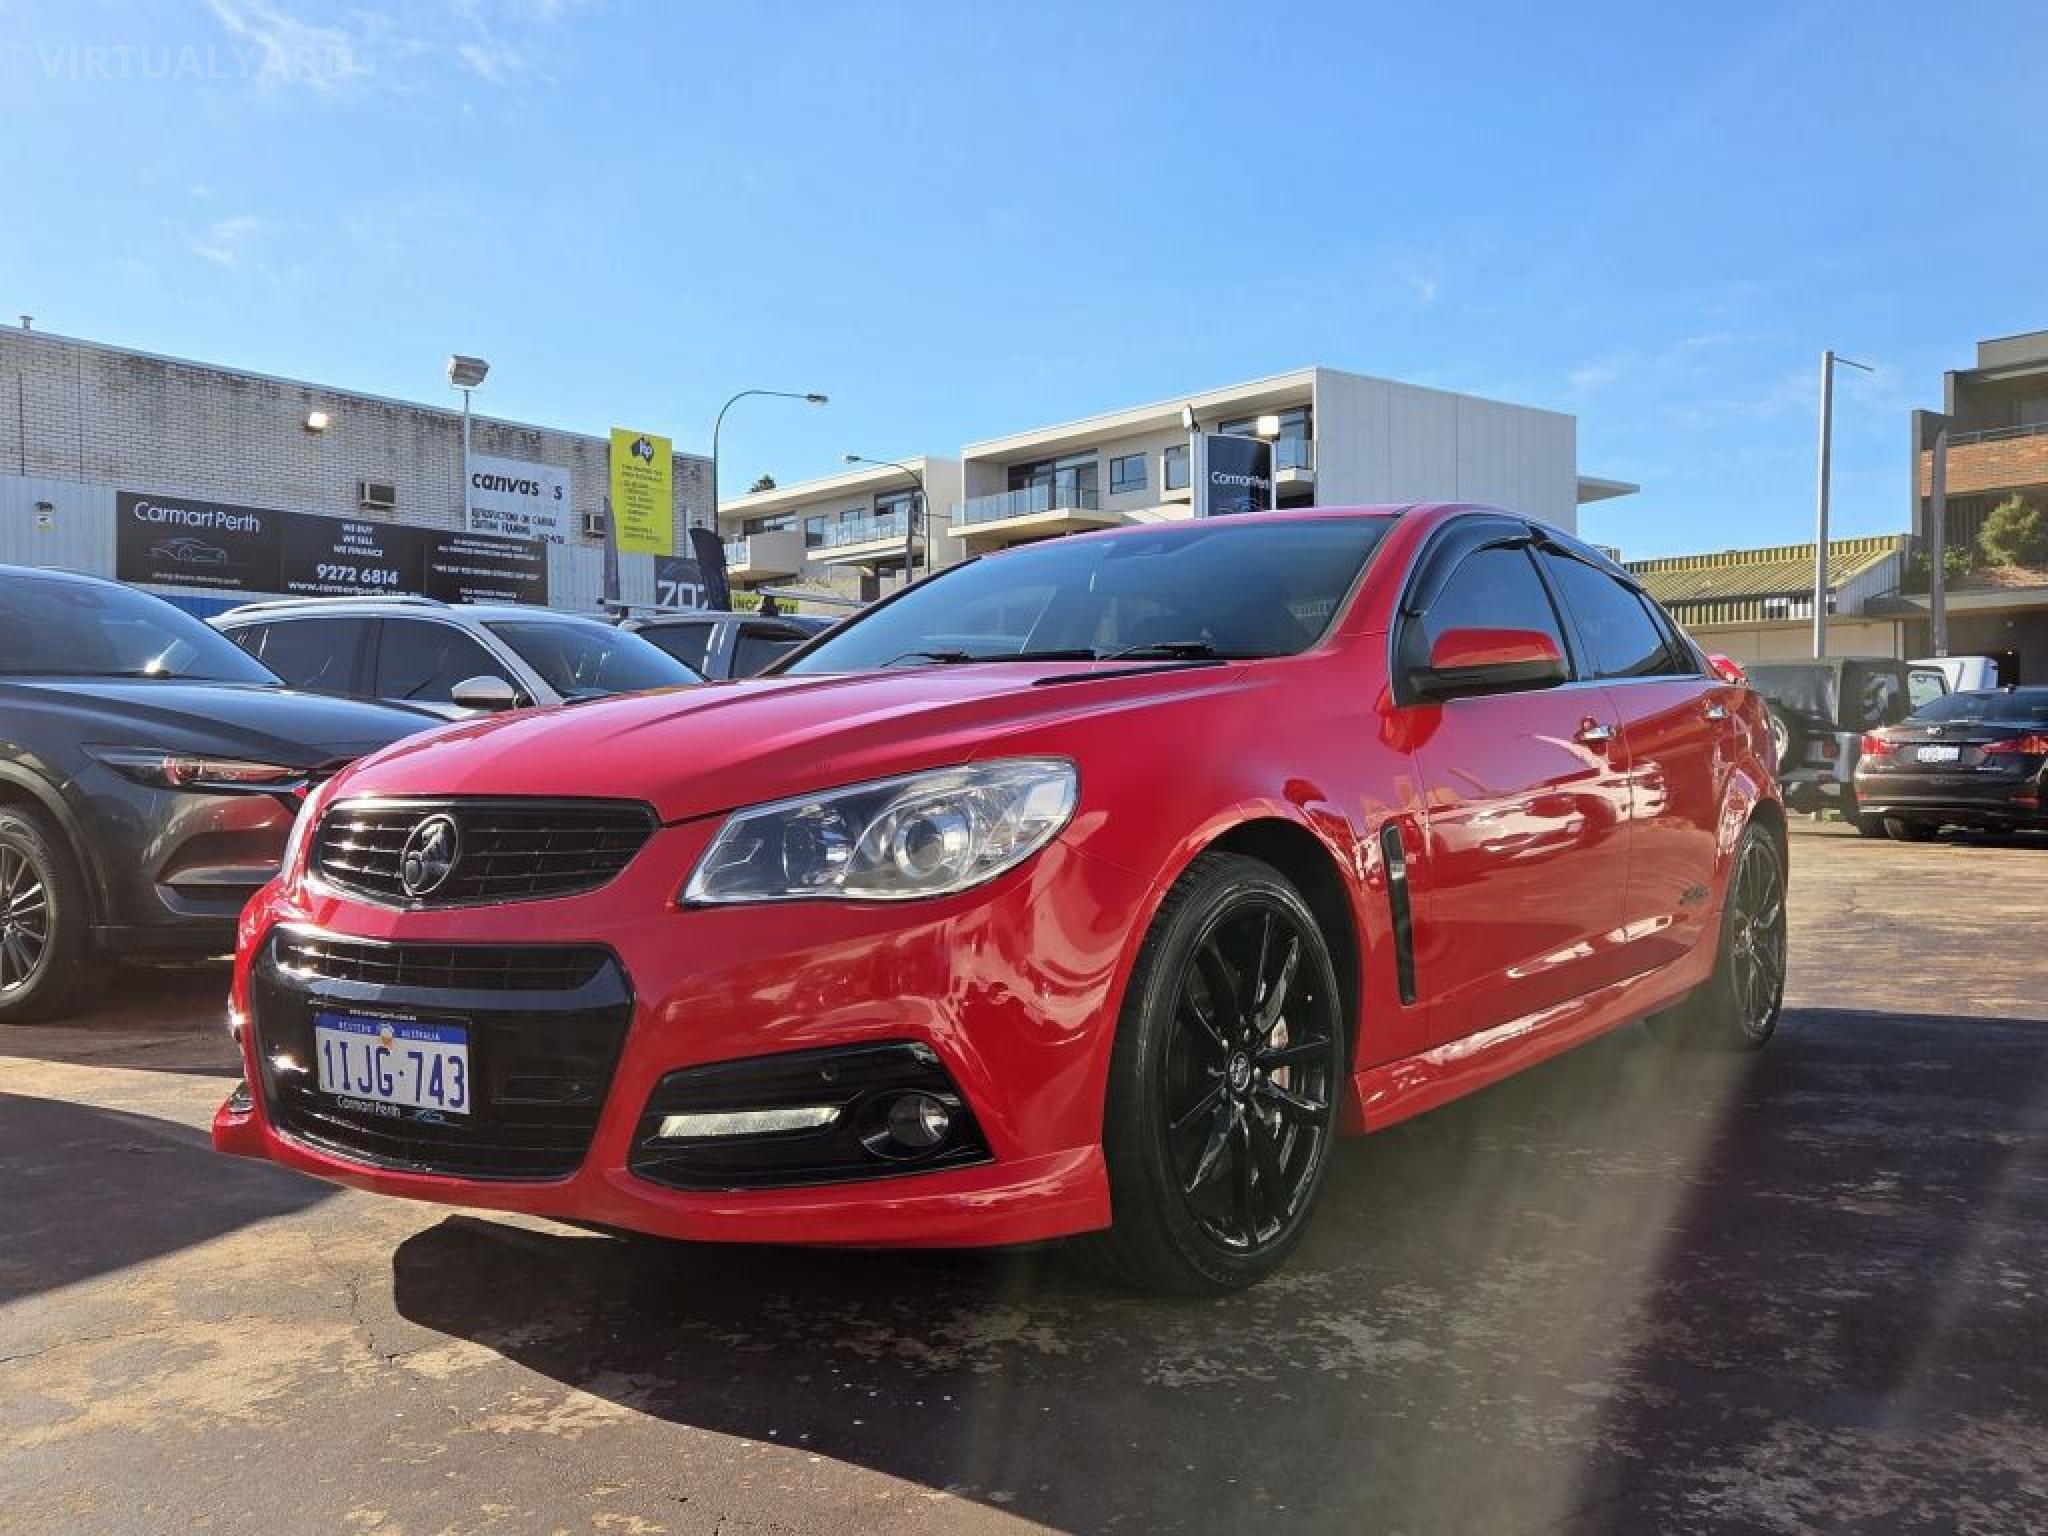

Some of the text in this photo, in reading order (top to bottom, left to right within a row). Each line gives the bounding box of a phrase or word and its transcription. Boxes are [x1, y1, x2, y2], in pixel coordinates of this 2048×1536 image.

[472, 473, 539, 497] canvas
[317, 563, 398, 585] 9272 6814
